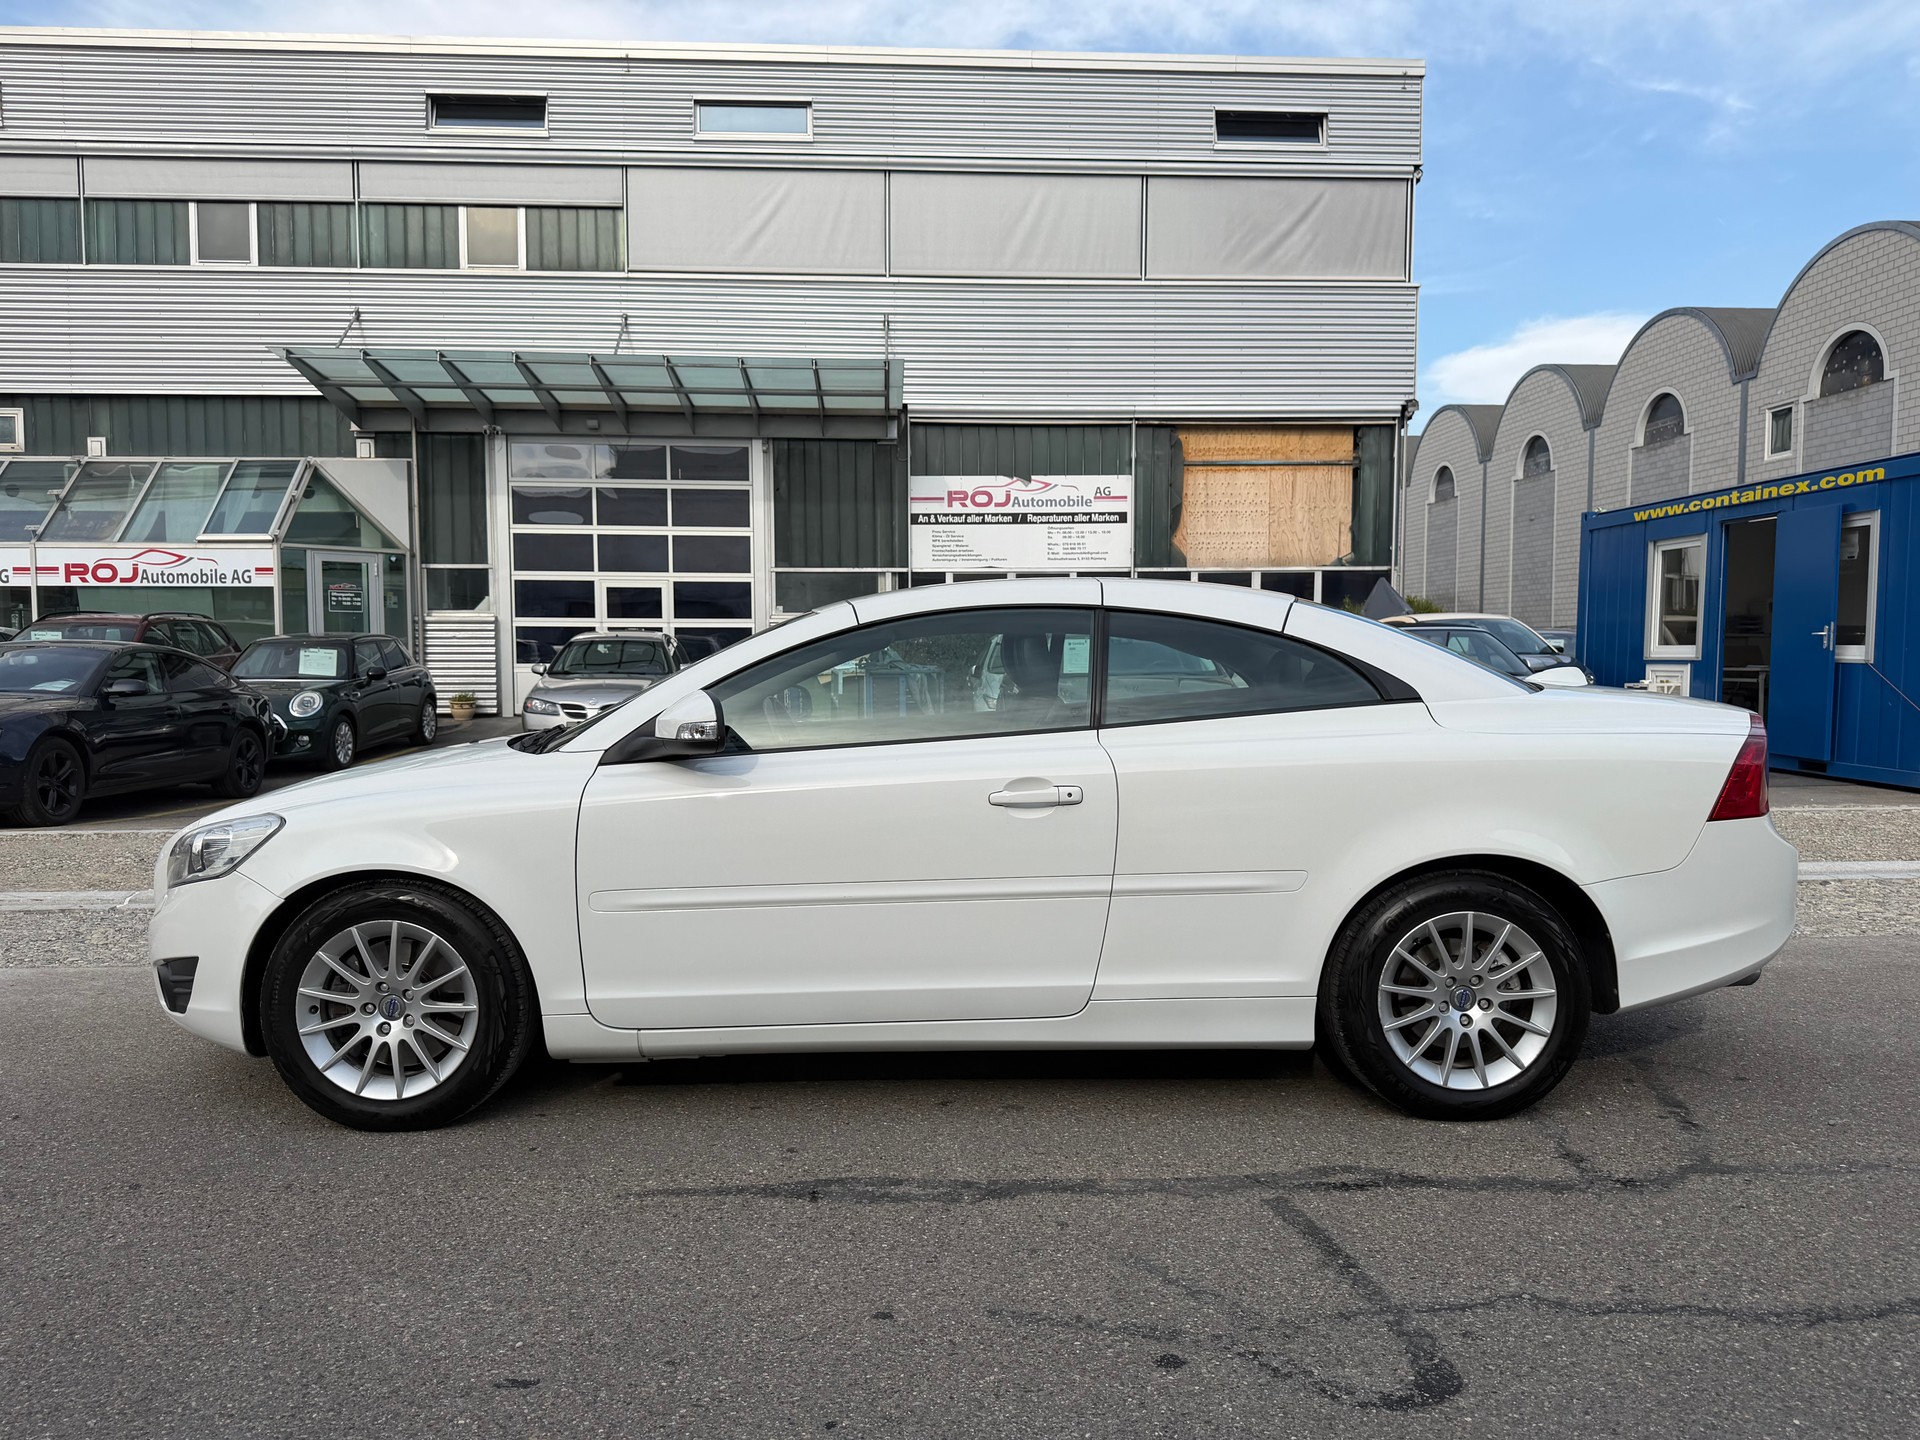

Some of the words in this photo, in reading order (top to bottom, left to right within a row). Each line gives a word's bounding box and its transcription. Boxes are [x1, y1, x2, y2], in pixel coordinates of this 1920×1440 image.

[947, 490, 1012, 508] ROJ
[1012, 495, 1093, 508] Automobile
[1094, 486, 1112, 496] AG
[1633, 467, 1885, 522] www.containex.com
[918, 515, 929, 523] An
[930, 515, 936, 523] &
[937, 514, 966, 523] Verkauf
[966, 514, 983, 523] aller
[984, 514, 1012, 523] Marken
[1027, 514, 1072, 524] Reparaturen
[1074, 514, 1092, 522] aller
[1092, 513, 1120, 522] Marken
[0, 569, 10, 584] G
[64, 563, 140, 583] ROJ
[140, 568, 227, 584] Automobile
[231, 569, 252, 584] AG
